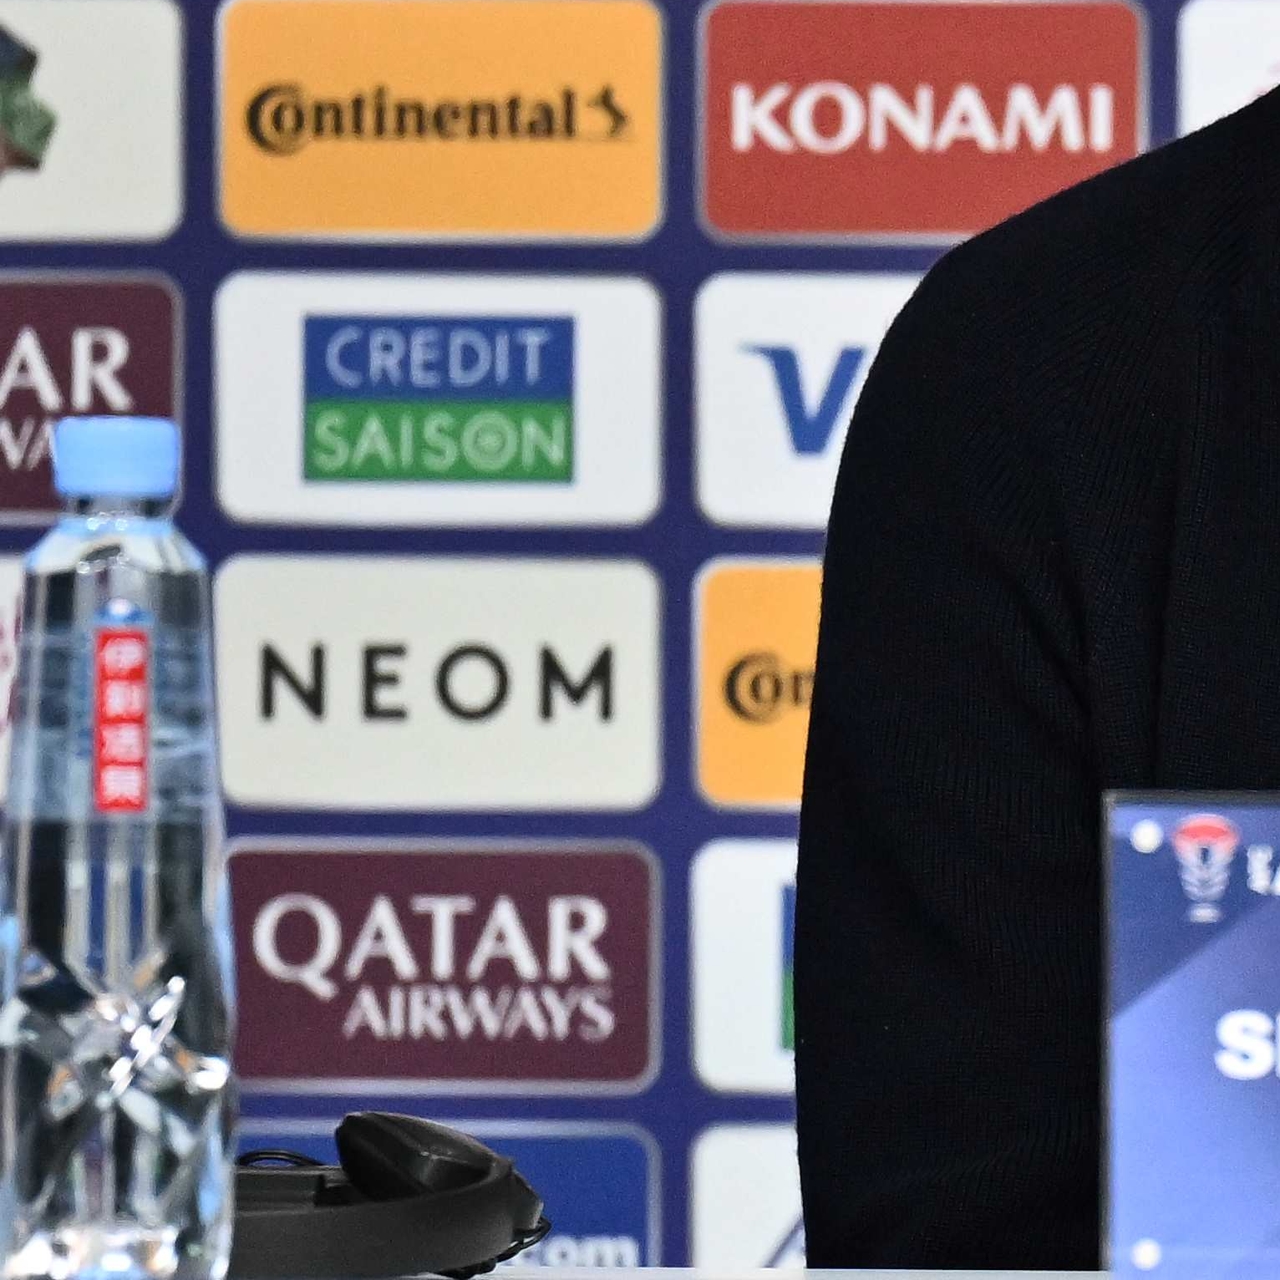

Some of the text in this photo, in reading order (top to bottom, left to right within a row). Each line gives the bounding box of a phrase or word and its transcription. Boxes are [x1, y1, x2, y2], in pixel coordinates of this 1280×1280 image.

[245, 84, 577, 156] Continental
[731, 83, 1114, 153] KONAMI
[327, 328, 548, 386] CREDIT
[313, 411, 566, 473] SAISON
[261, 644, 613, 722] NEOM
[253, 893, 611, 999] QATAR
[344, 985, 615, 1039] AIRWAYS
